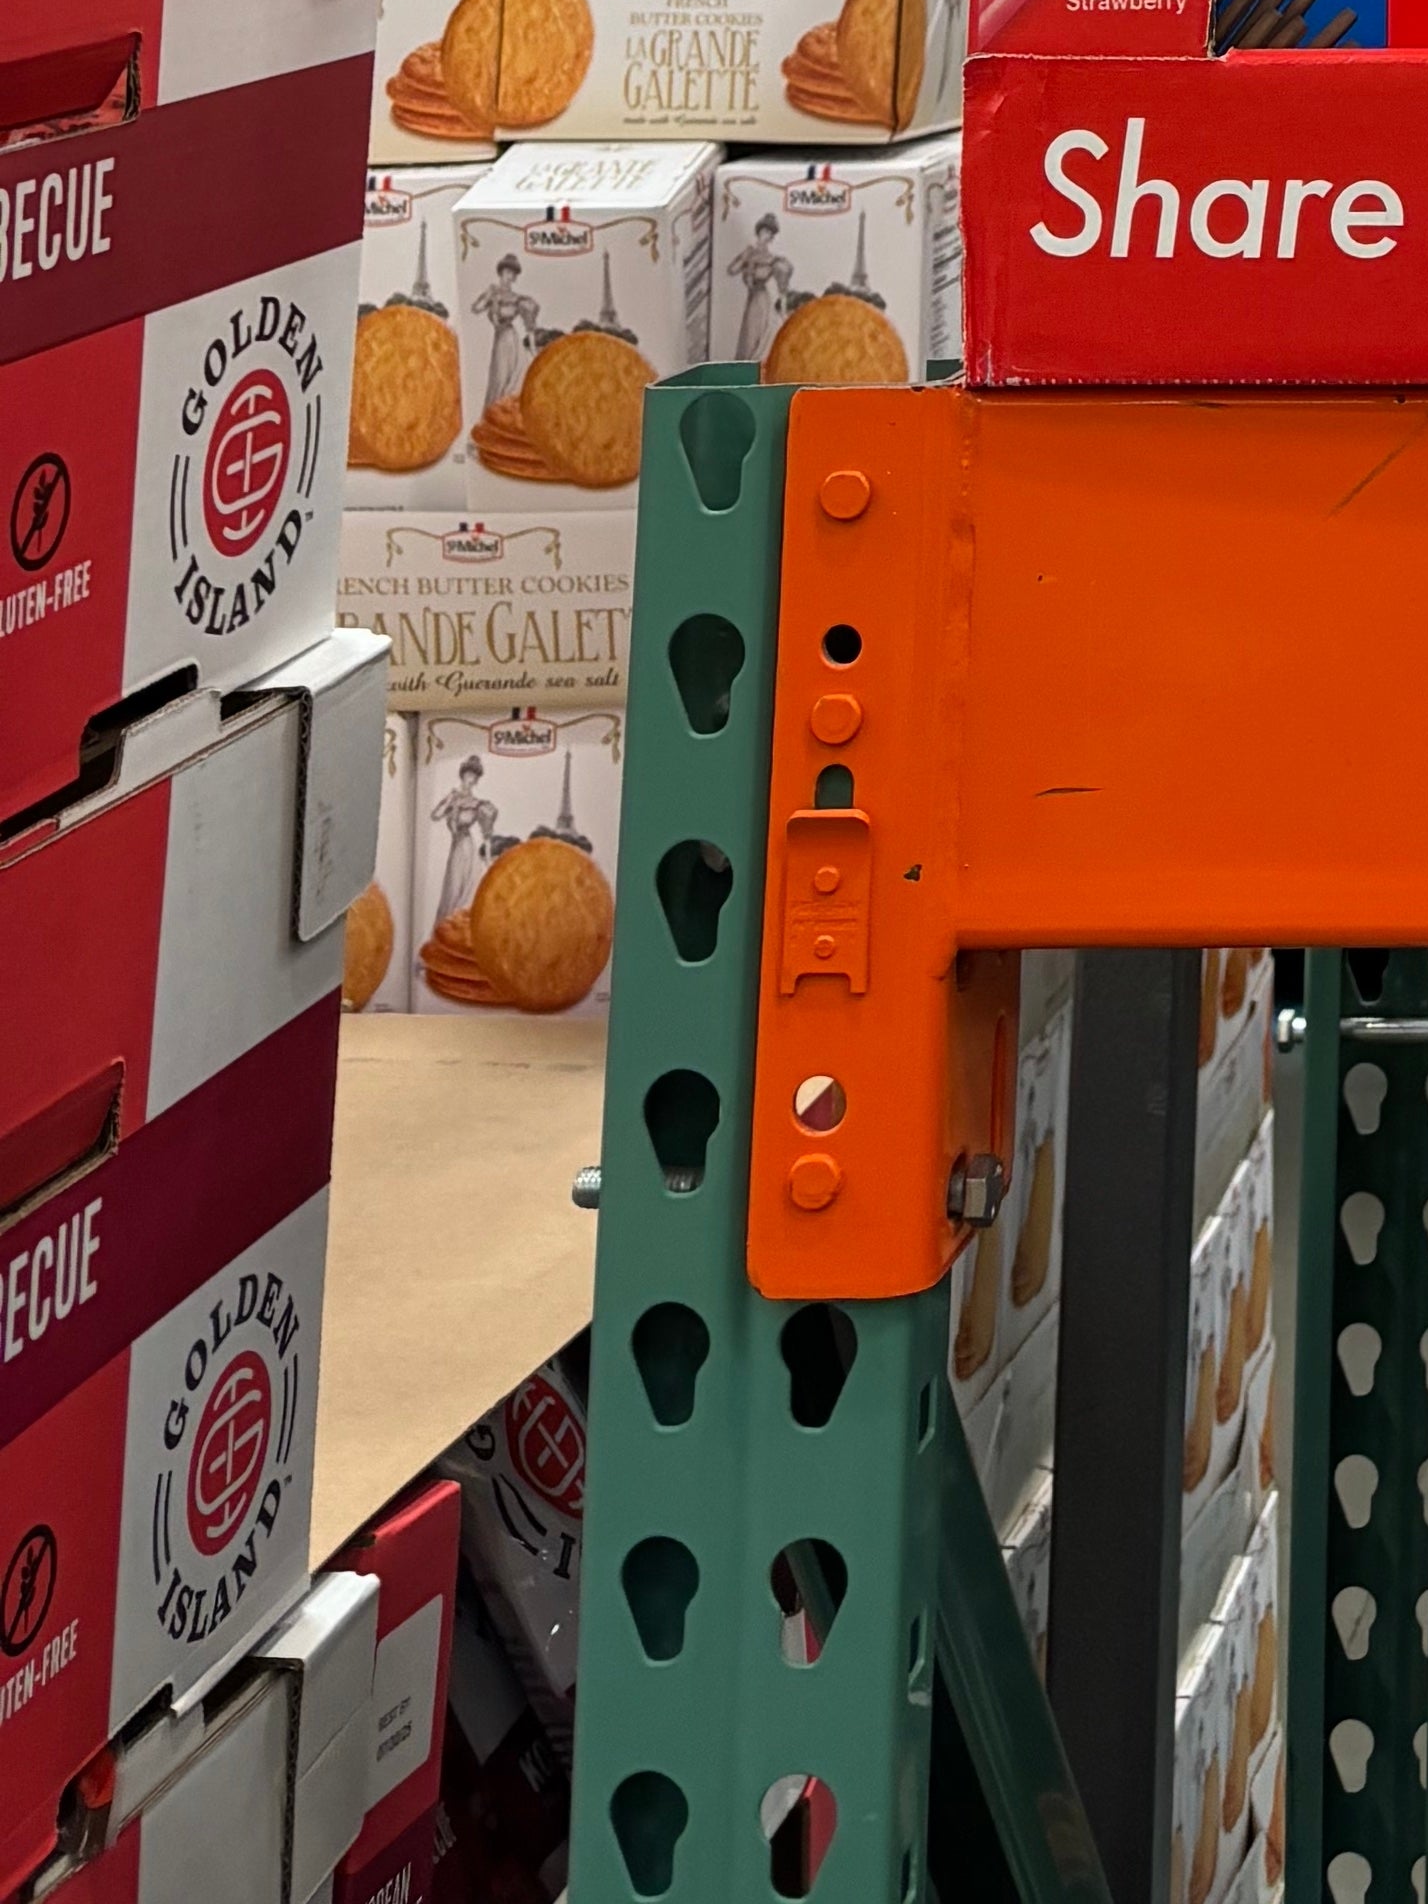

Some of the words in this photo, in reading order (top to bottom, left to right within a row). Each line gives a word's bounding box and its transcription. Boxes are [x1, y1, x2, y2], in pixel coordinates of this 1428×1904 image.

[1029, 117, 1404, 258] Share
[180, 296, 324, 436] GOLDEN
[174, 507, 304, 636] ISLAND
